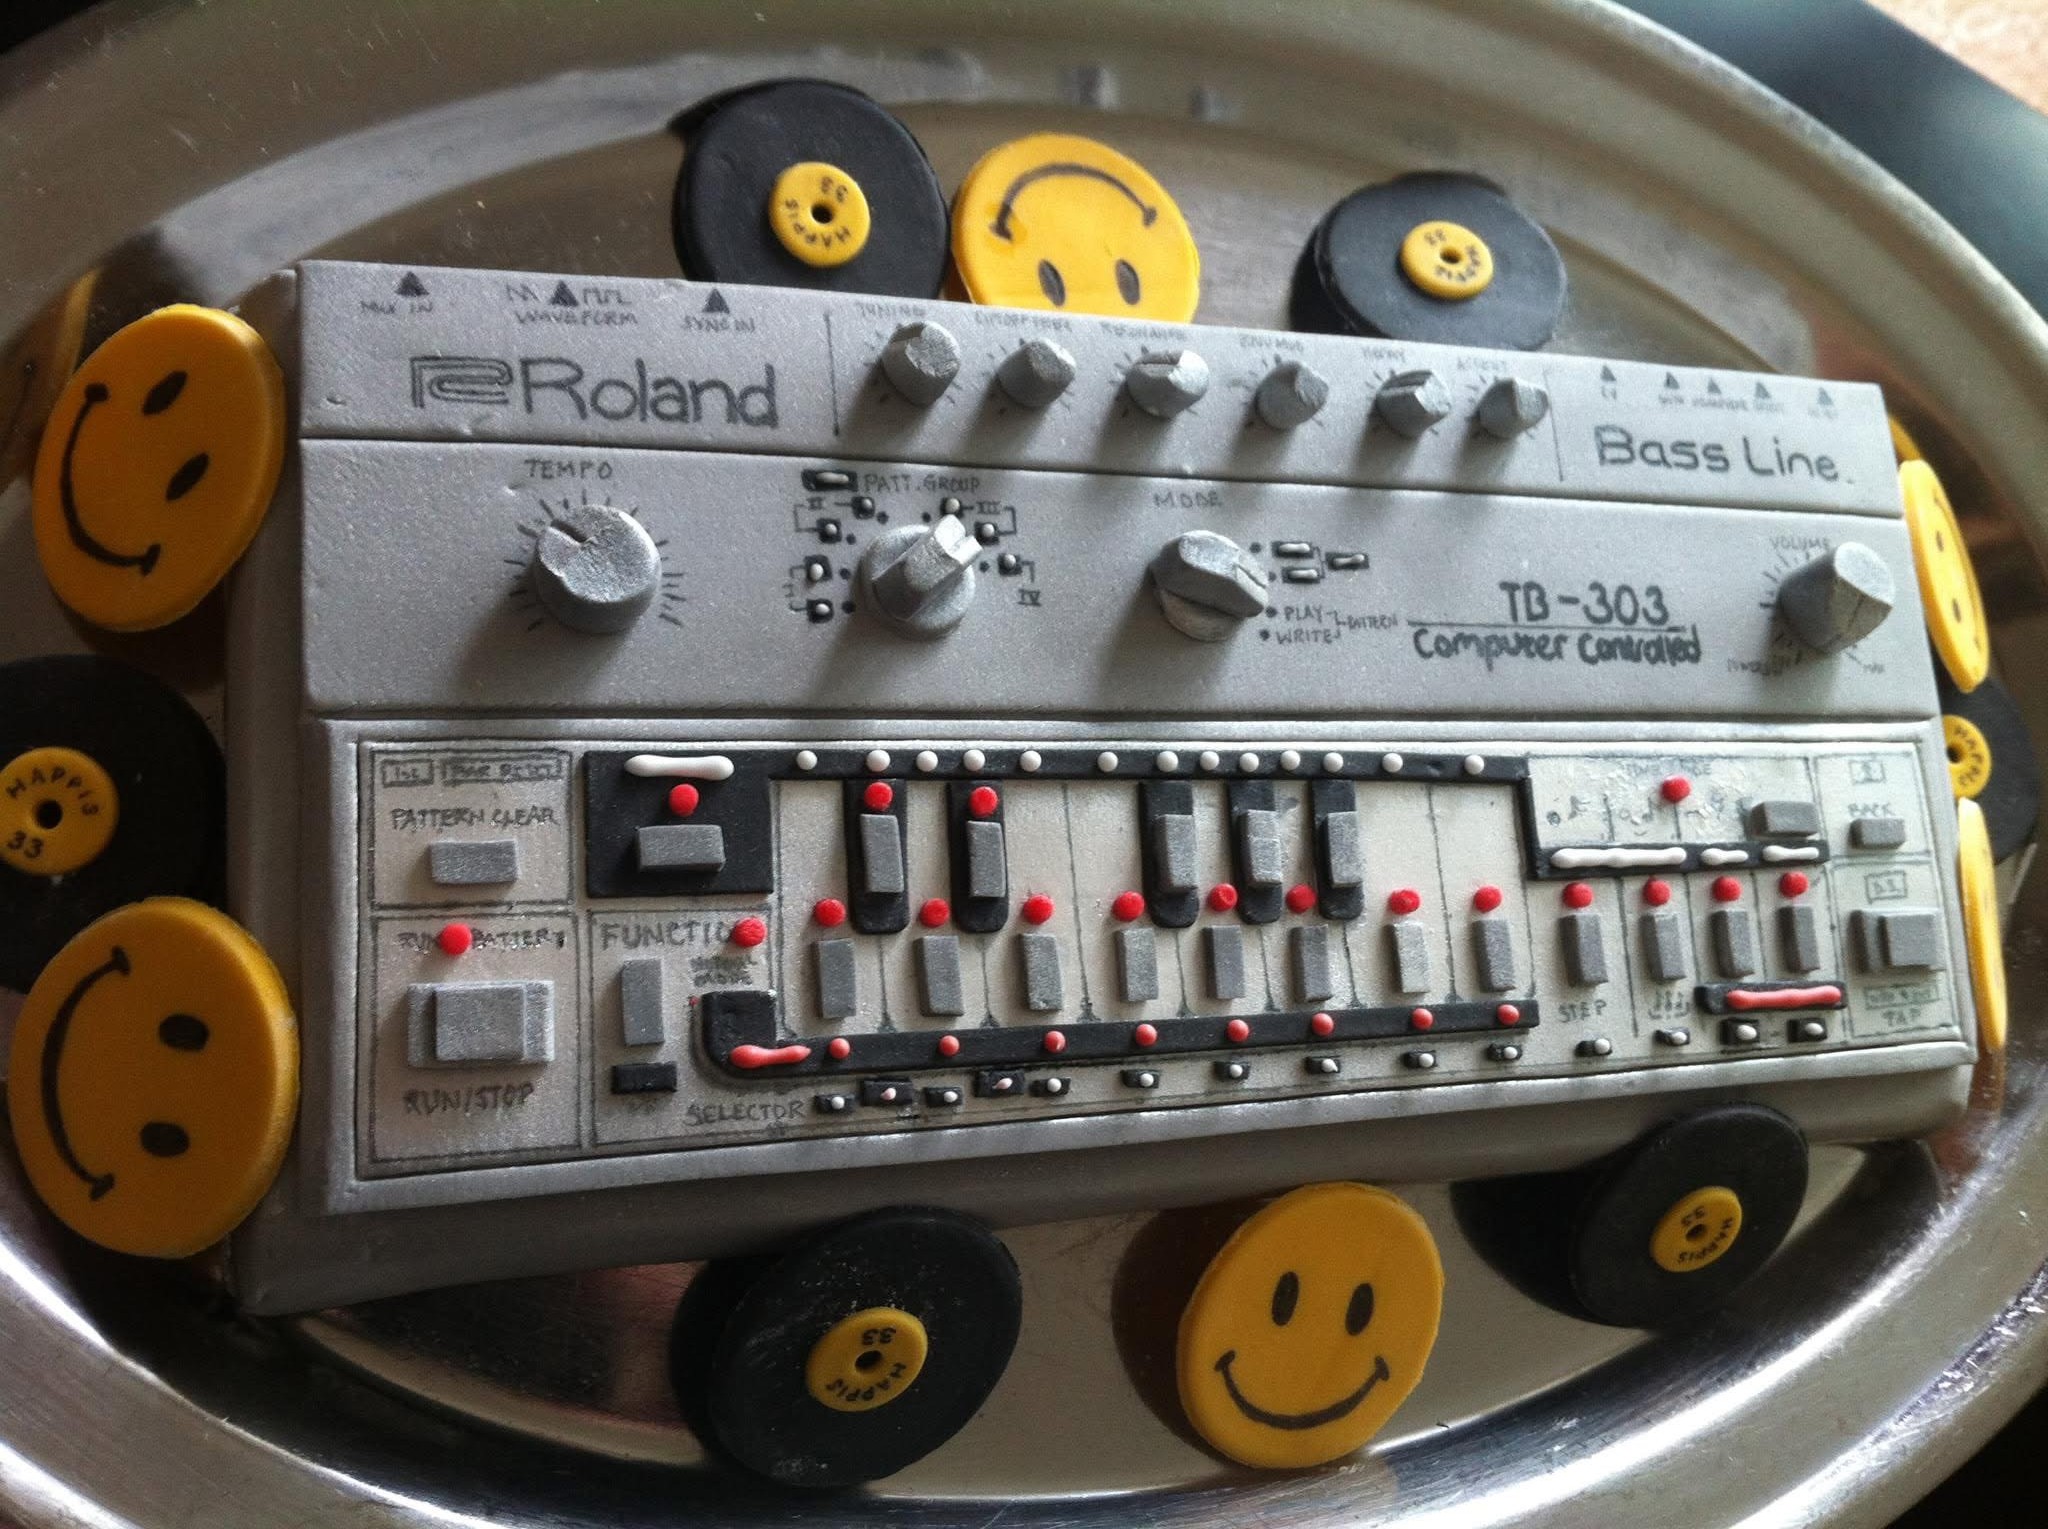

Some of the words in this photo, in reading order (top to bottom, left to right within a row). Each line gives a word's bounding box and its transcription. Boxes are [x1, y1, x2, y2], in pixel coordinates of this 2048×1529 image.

[514, 309, 638, 328] WAVEFORM
[520, 357, 778, 428] Roland
[1594, 424, 1730, 473] Bass
[524, 458, 613, 479] TEMPO
[1154, 492, 1223, 508] MODE
[1769, 536, 1831, 551] VOLUME
[1284, 605, 1323, 623] PLAY
[1499, 580, 1669, 626] TB-303
[1276, 628, 1333, 645] WRITE
[1413, 627, 1569, 672] Computer
[390, 807, 485, 831] PATTERN
[491, 804, 561, 831] CLEAR
[6, 829, 45, 859] 33
[1558, 1000, 1607, 1024] STEP
[684, 1100, 805, 1127] SELECTOR
[861, 1326, 898, 1346] 33
